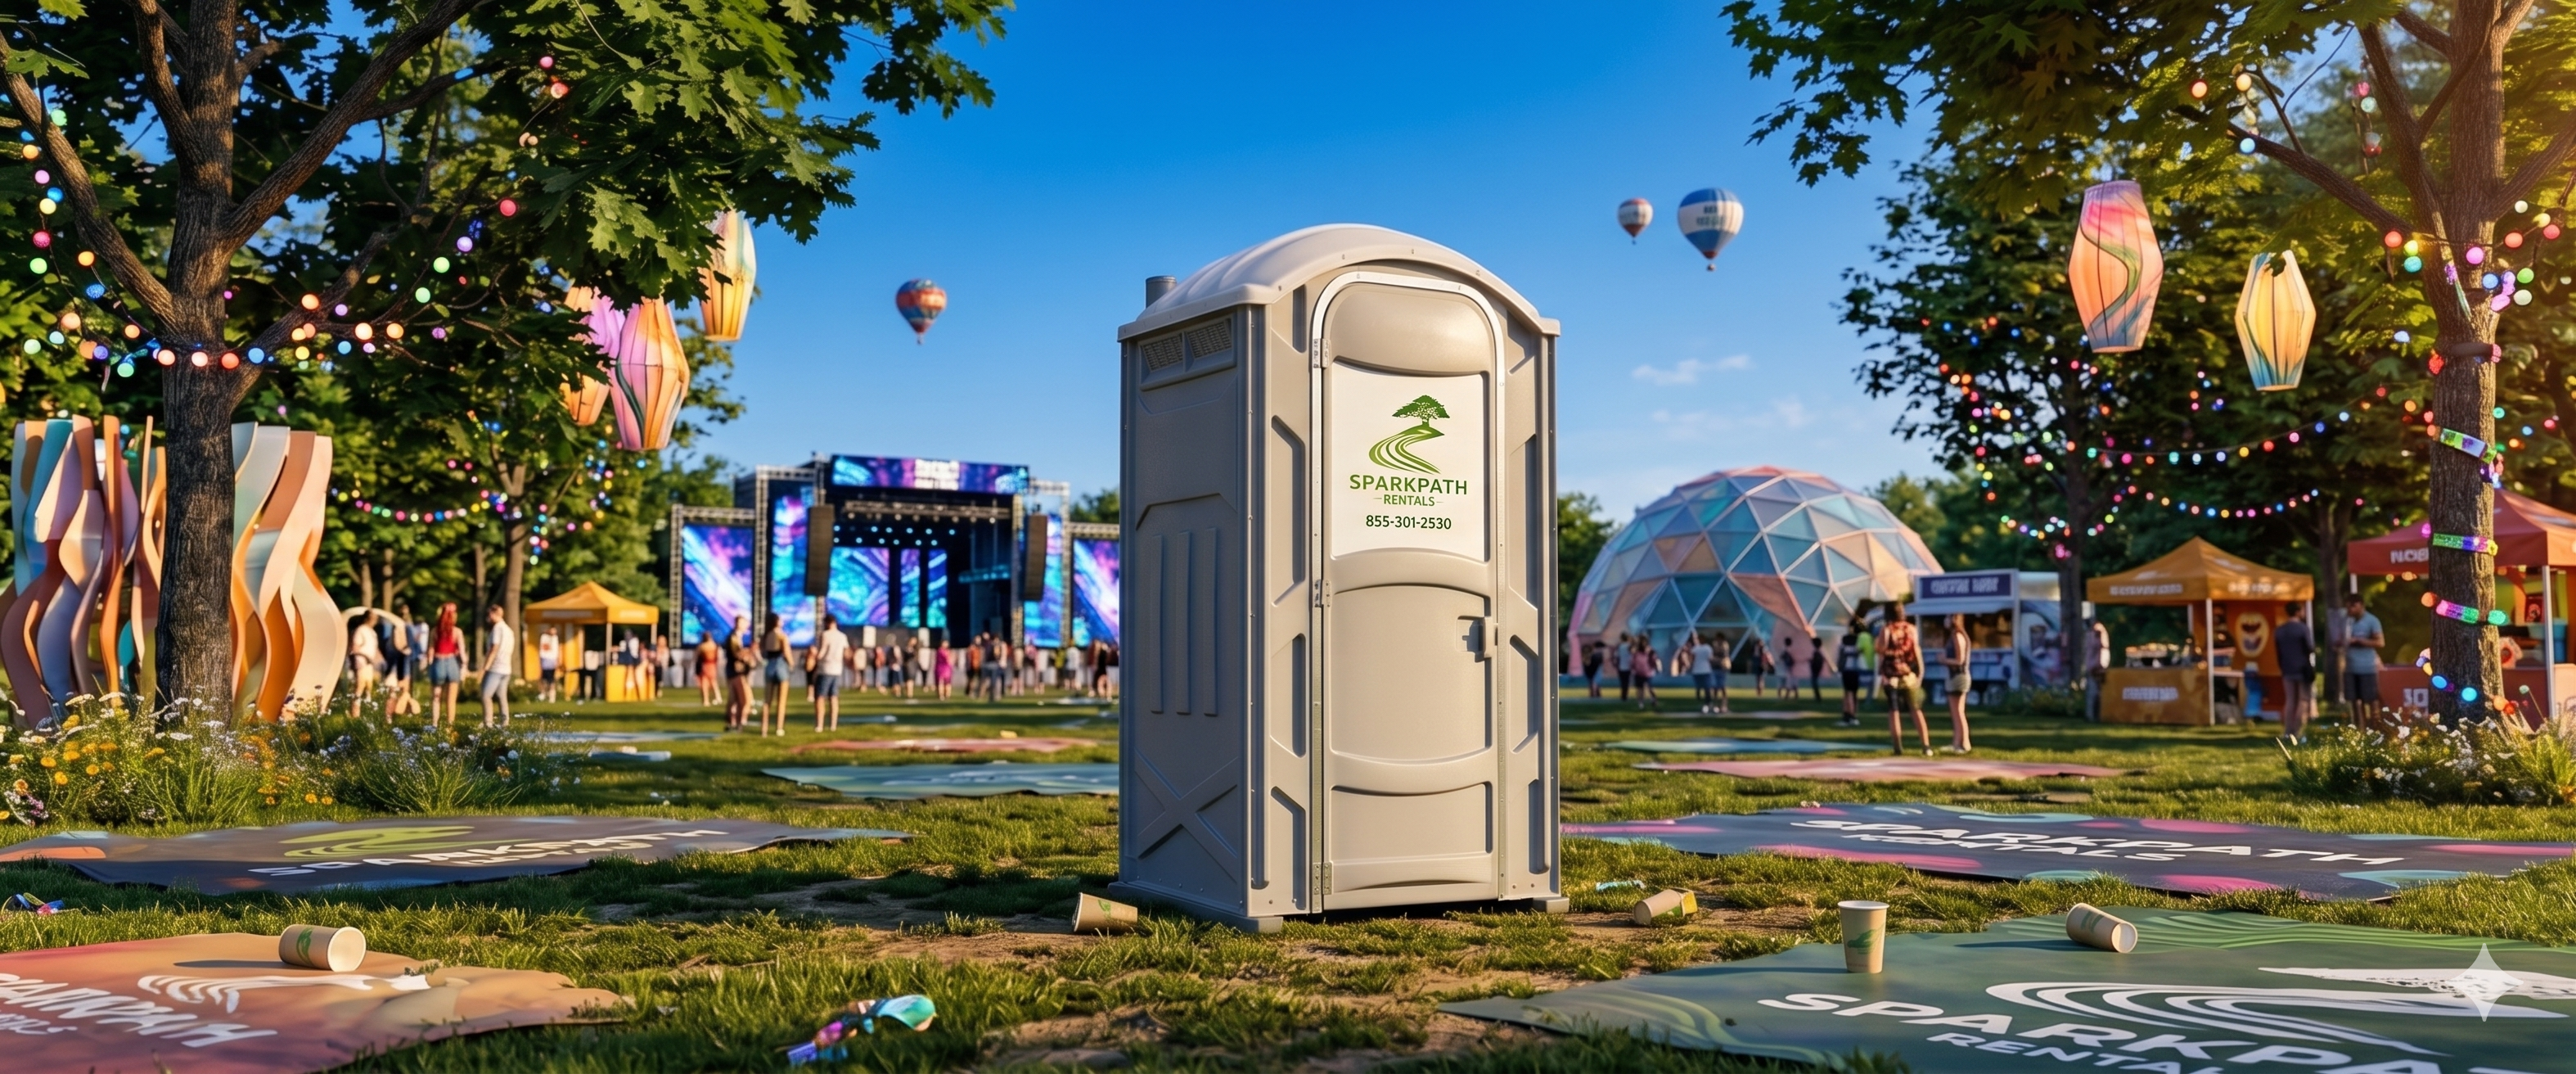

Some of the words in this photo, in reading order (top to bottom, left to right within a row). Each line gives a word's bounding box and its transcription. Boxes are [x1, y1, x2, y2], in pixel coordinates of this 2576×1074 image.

[1349, 474, 1467, 495] SPARKPATH
[1383, 494, 1435, 507] RENTALS
[1366, 515, 1452, 530] 855-301-2530
[1790, 819, 2404, 864] SPARKPATH
